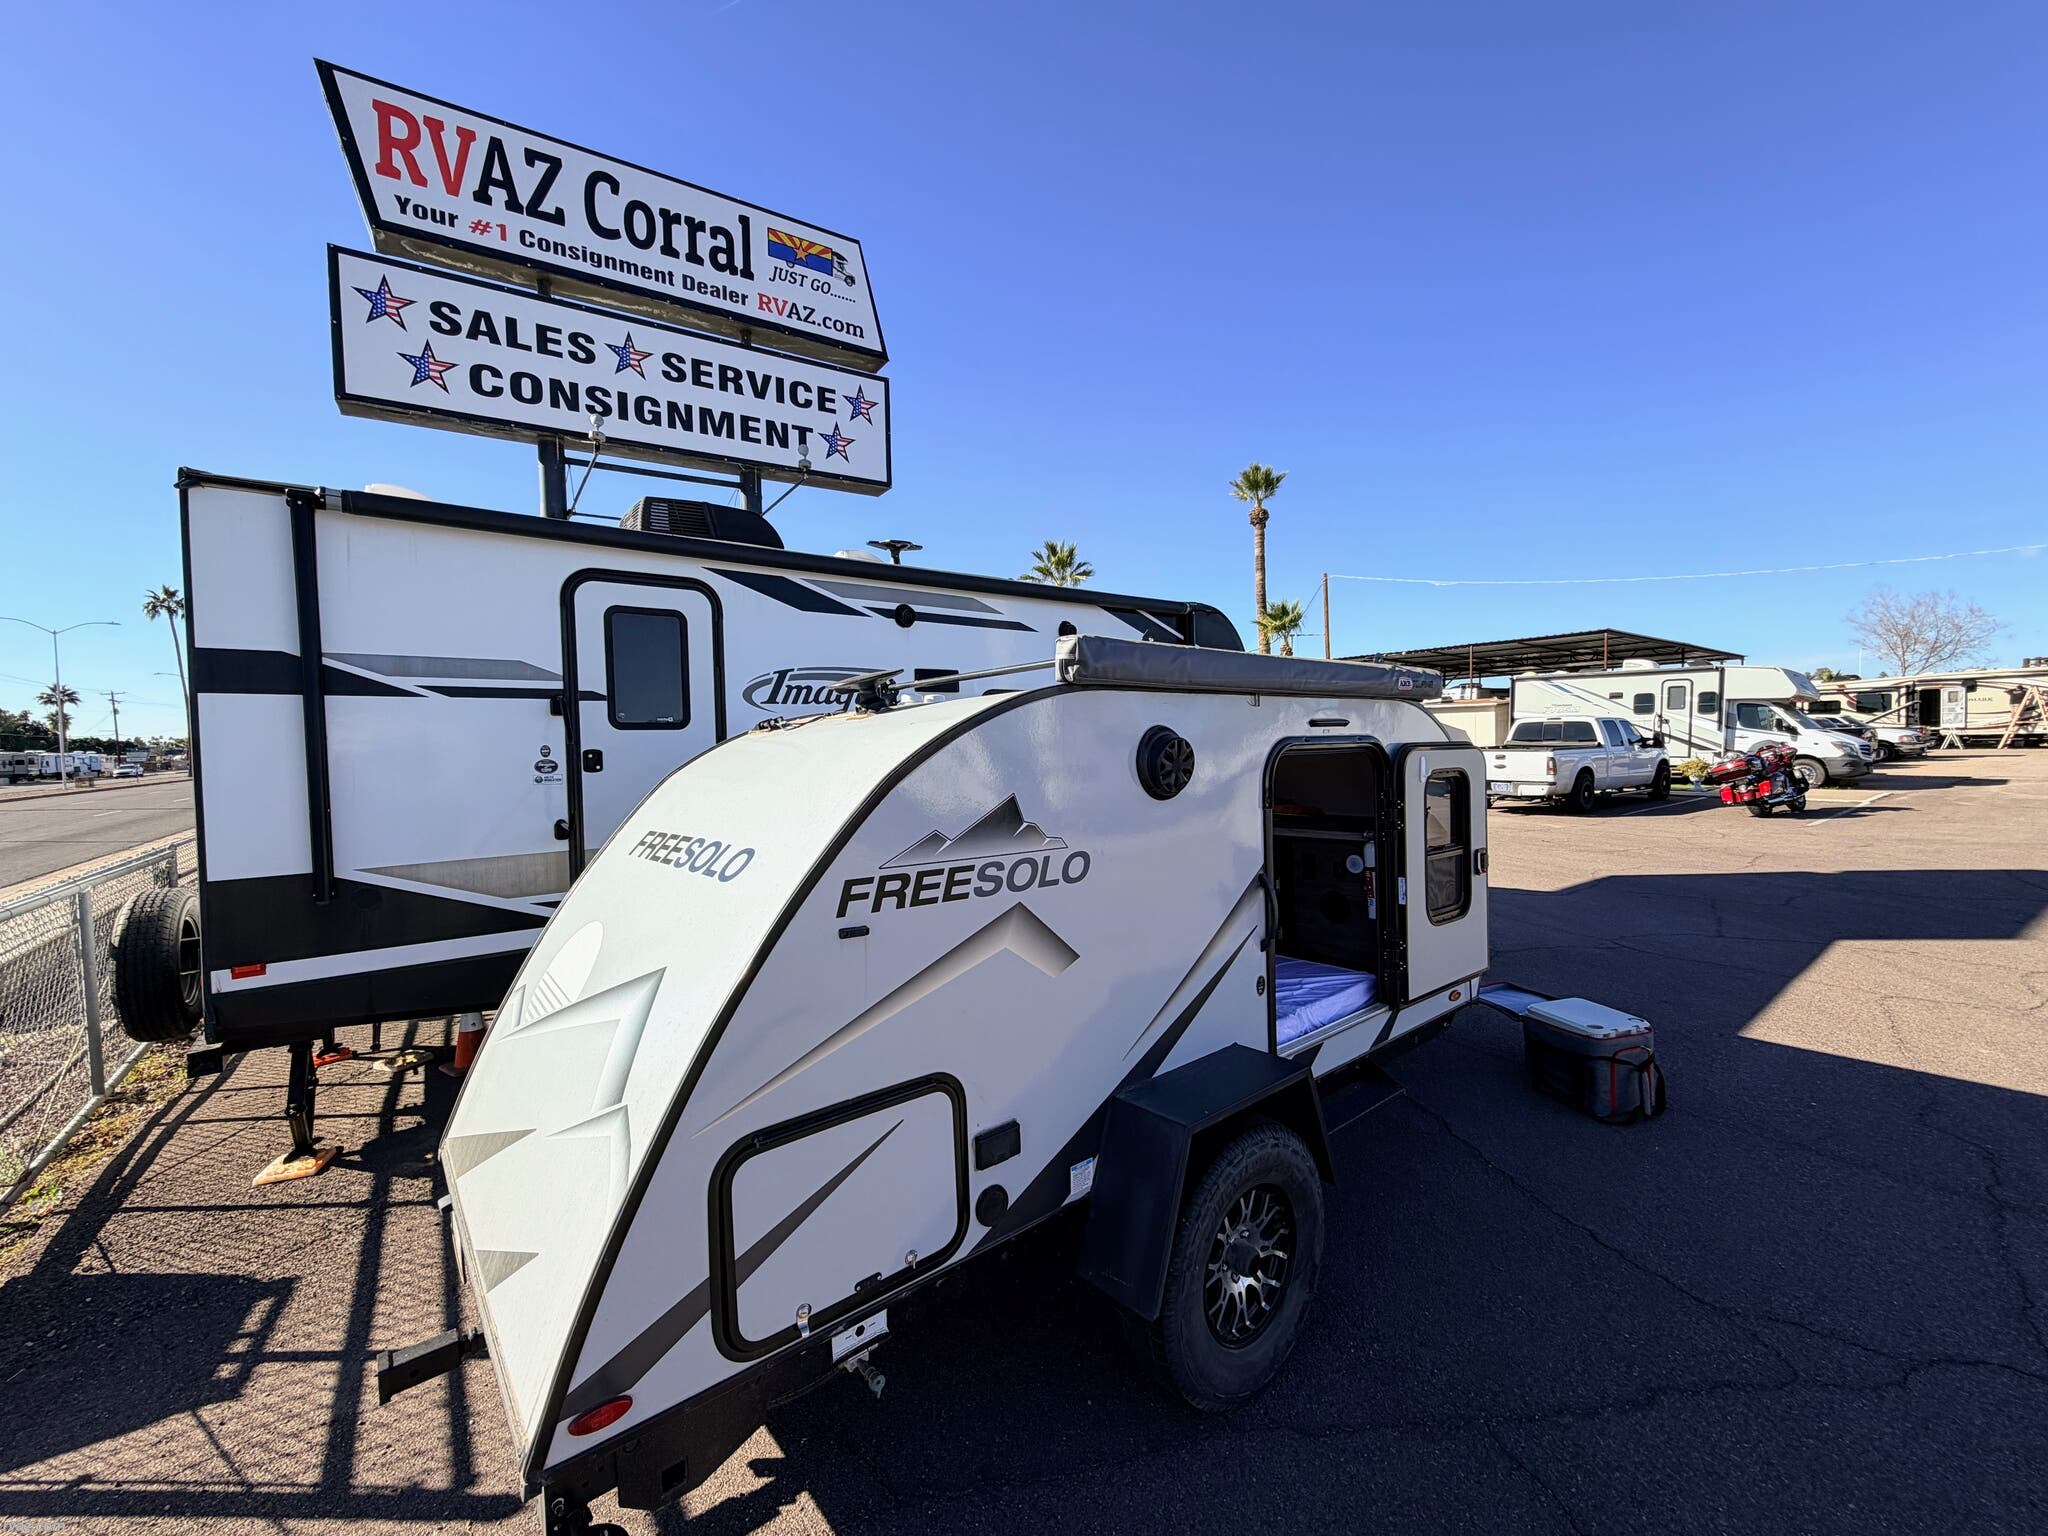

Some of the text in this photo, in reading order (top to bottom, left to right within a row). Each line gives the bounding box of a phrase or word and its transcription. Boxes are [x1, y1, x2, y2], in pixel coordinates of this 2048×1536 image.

[372, 98, 755, 282] RVAZ Corral
[394, 194, 865, 339] Your #1 Consignment Dealer RVAZ.com
[769, 266, 808, 288] JUST
[429, 300, 837, 415] SALES SERVICE
[469, 363, 813, 449] CONSIGNMENT
[760, 668, 858, 713] Imag
[628, 830, 756, 882] FREESOLO
[836, 850, 1091, 919] FREESOLO
